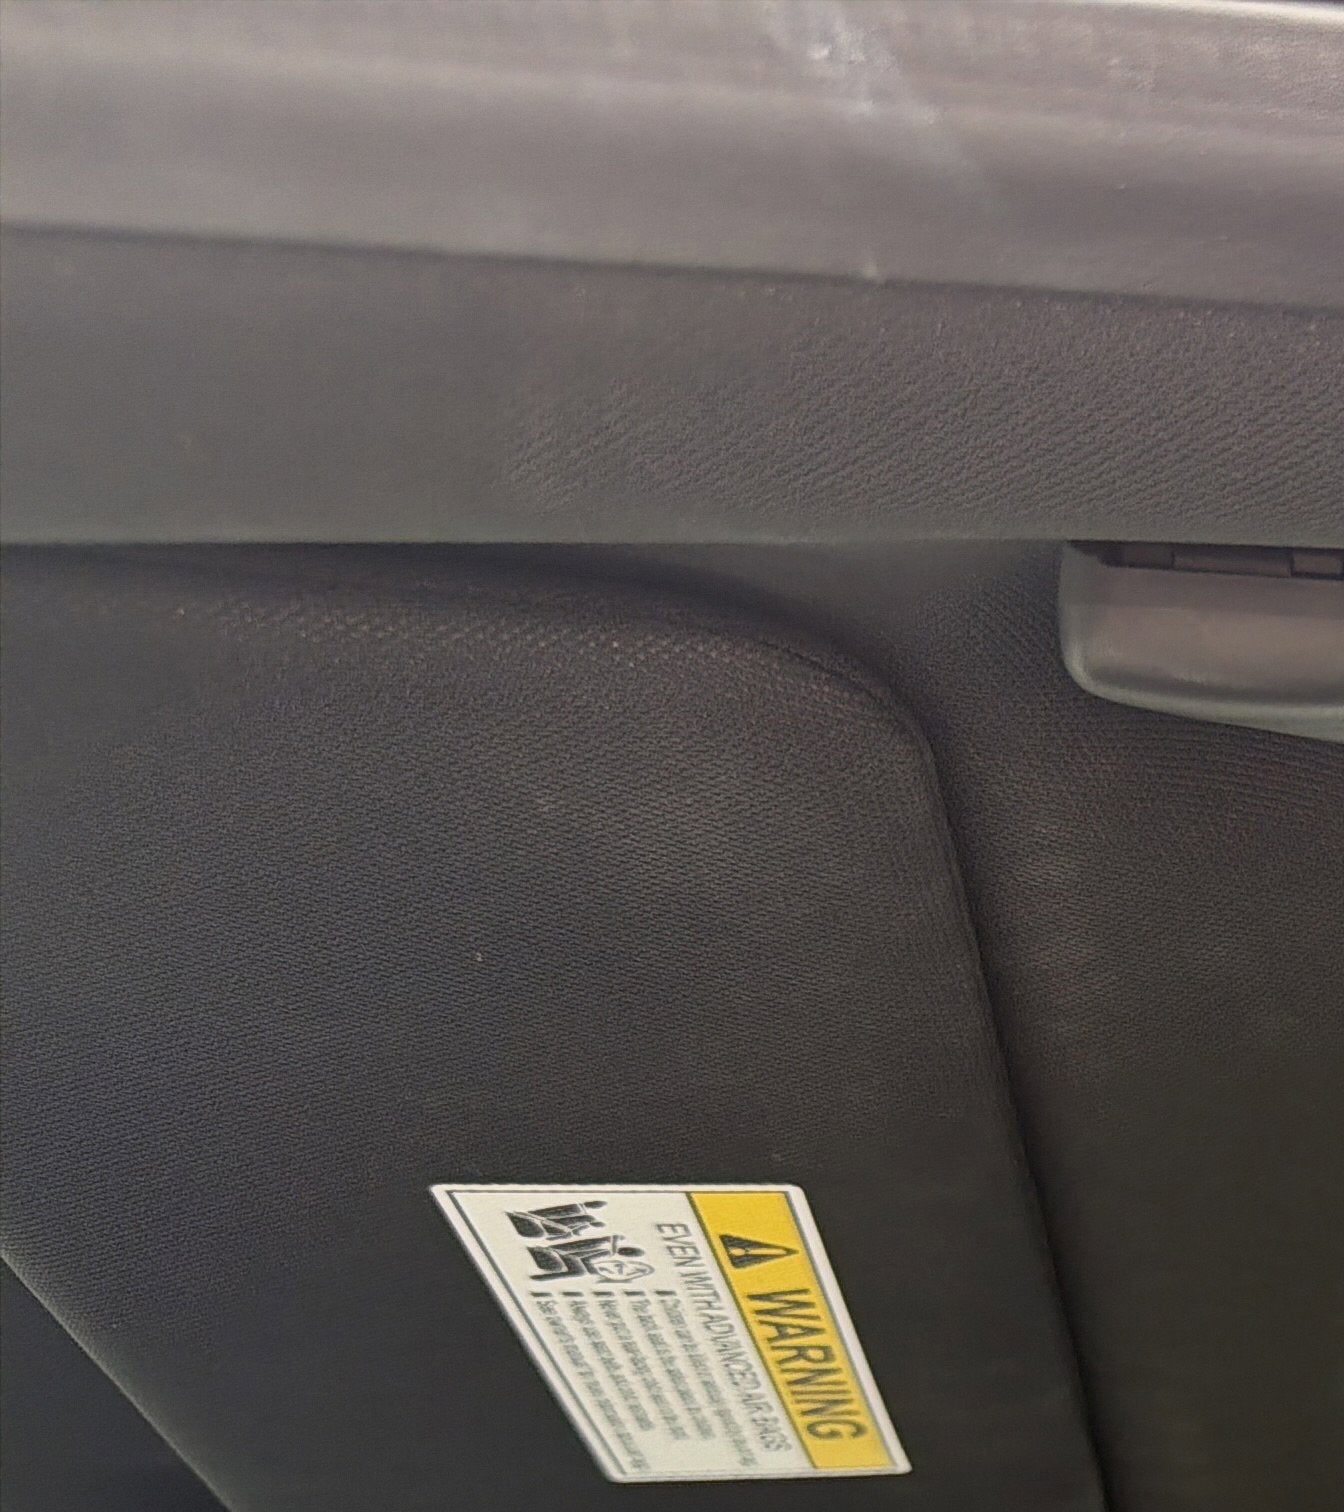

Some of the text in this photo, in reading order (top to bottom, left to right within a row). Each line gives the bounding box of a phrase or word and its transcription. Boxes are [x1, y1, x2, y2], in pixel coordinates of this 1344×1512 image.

[656, 1223, 705, 1267] EVEN
[680, 1271, 725, 1311] WITH
[700, 1312, 761, 1390] ADVANCED
[746, 1288, 868, 1439] WARNING
[742, 1392, 774, 1415] AIR
[752, 1416, 792, 1451] BAGS
